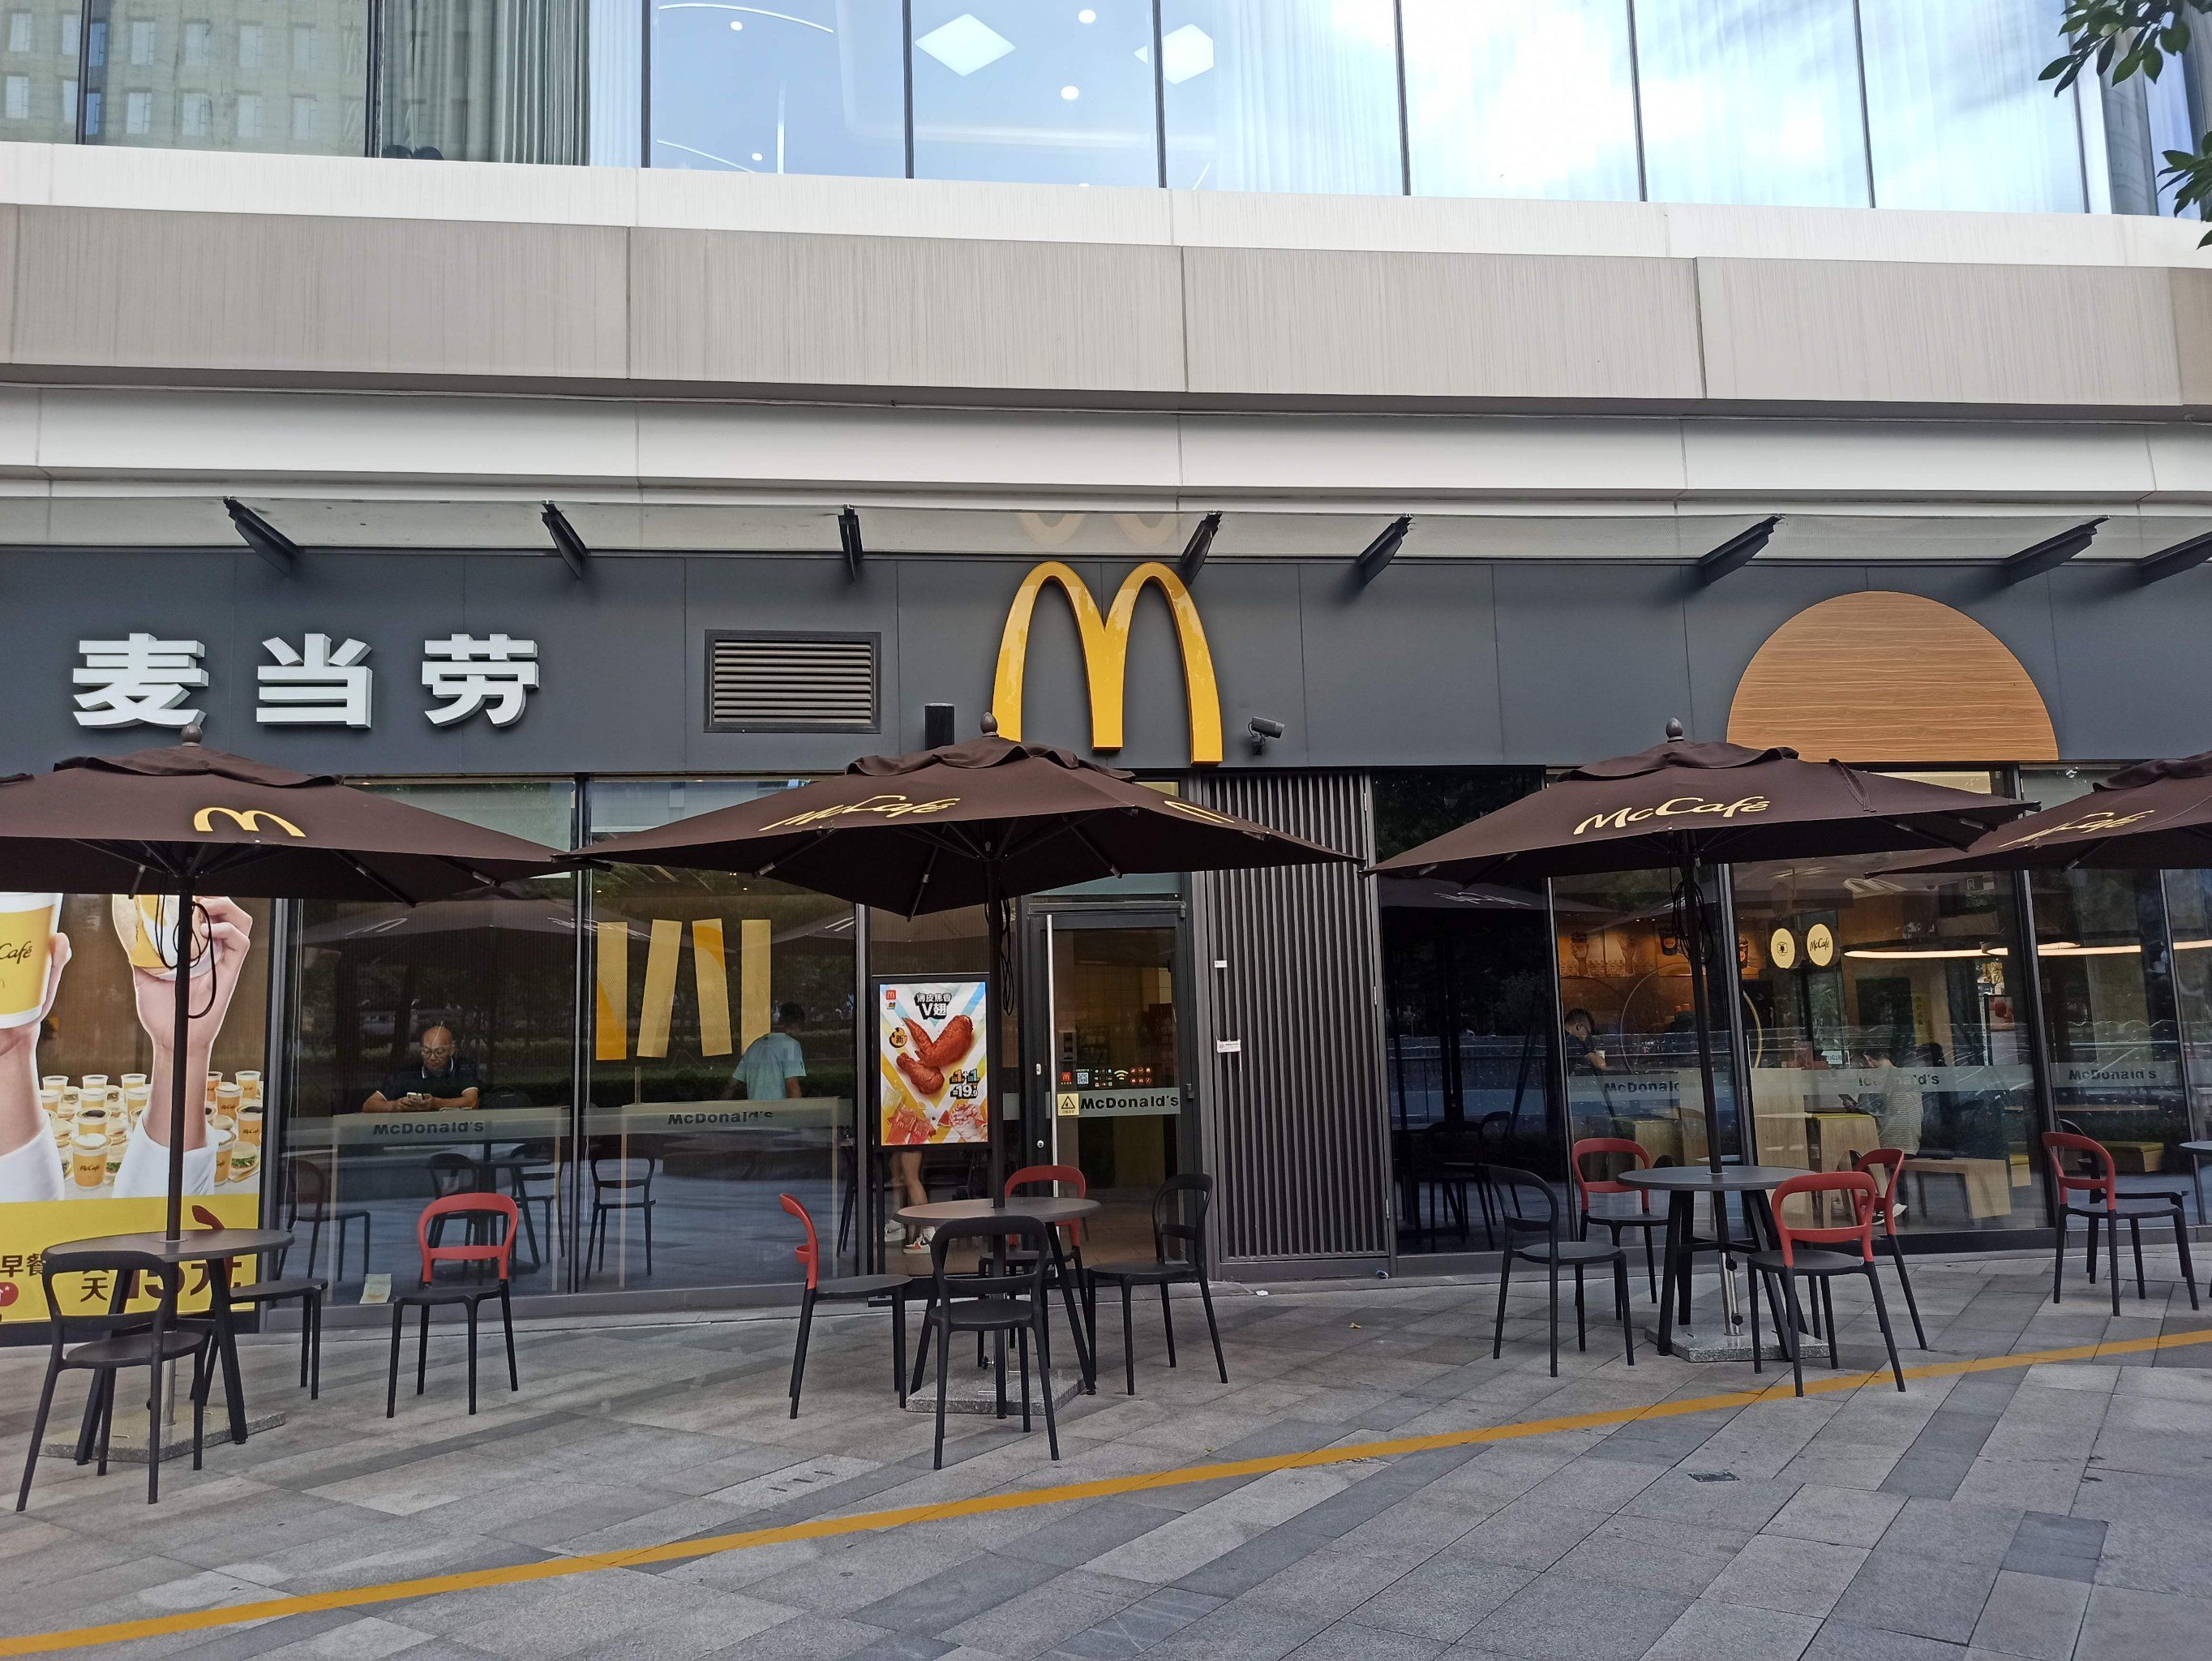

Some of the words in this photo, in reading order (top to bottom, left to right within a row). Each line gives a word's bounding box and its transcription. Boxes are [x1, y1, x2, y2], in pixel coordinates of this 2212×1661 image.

[72, 633, 539, 728] 麦当劳
[759, 795, 961, 831] McCafé
[1573, 796, 1770, 835] McCafé
[2068, 1069, 2157, 1080] McDonalds
[1081, 1095, 1179, 1109] McDonald's
[372, 1122, 484, 1135] McDonald's
[0, 1253, 45, 1278] 早餐
